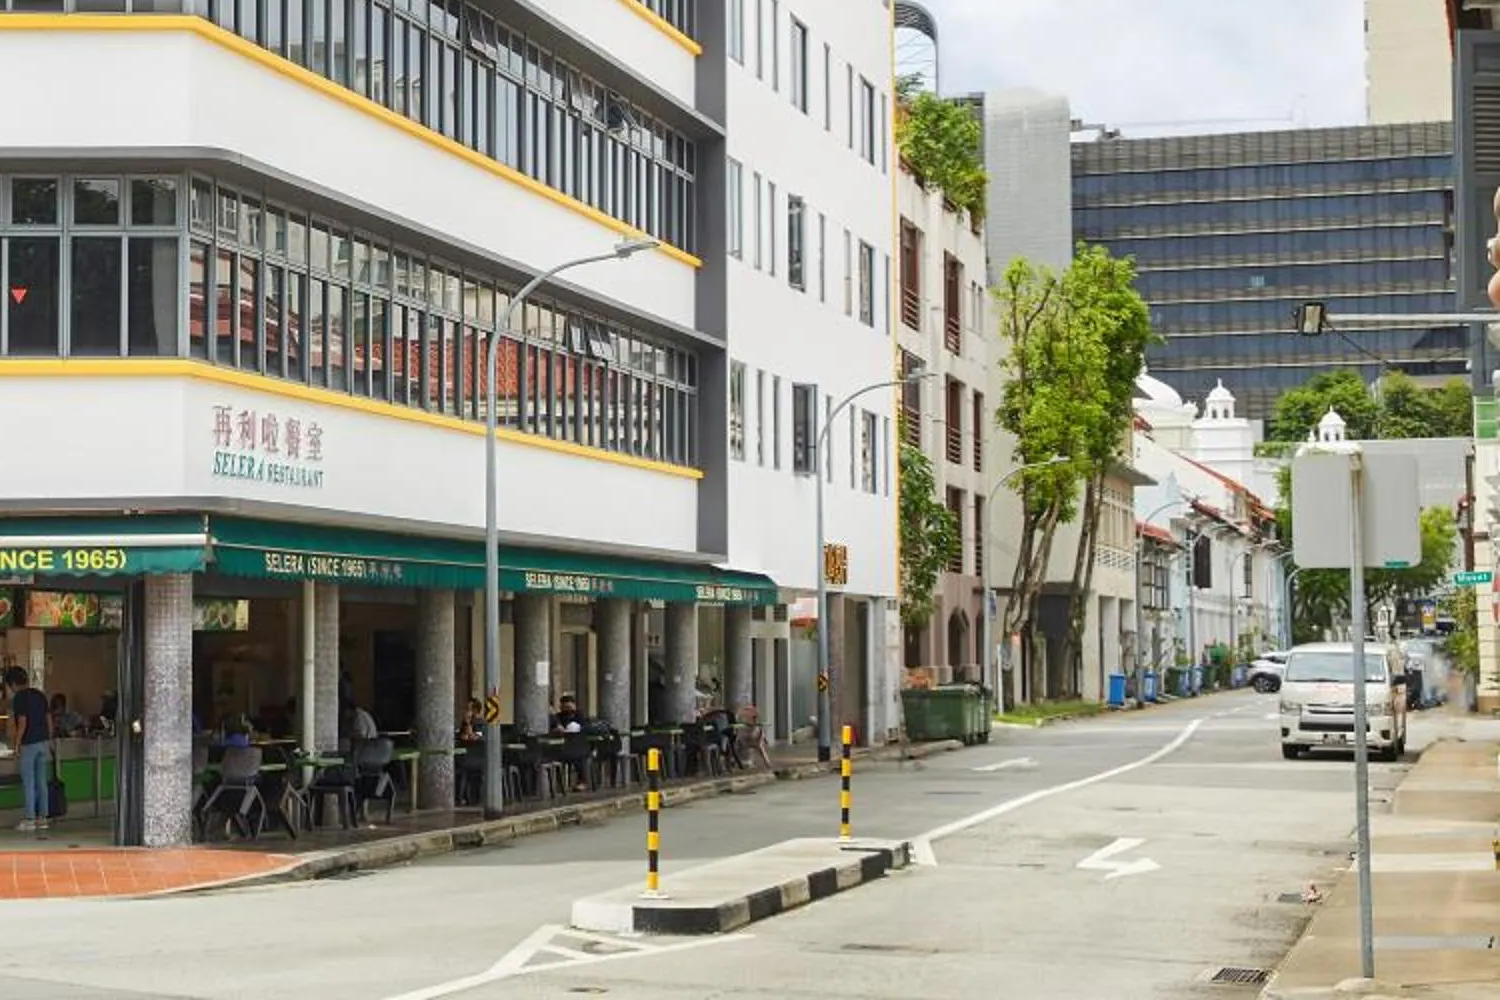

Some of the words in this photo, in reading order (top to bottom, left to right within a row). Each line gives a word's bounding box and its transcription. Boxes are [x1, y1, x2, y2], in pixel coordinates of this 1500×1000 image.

[212, 450, 265, 481] SELERA
[266, 462, 324, 488] RESTAURANT
[61, 548, 129, 571] 1965)
[264, 551, 304, 574] SELERA
[307, 555, 340, 577] (SINCE
